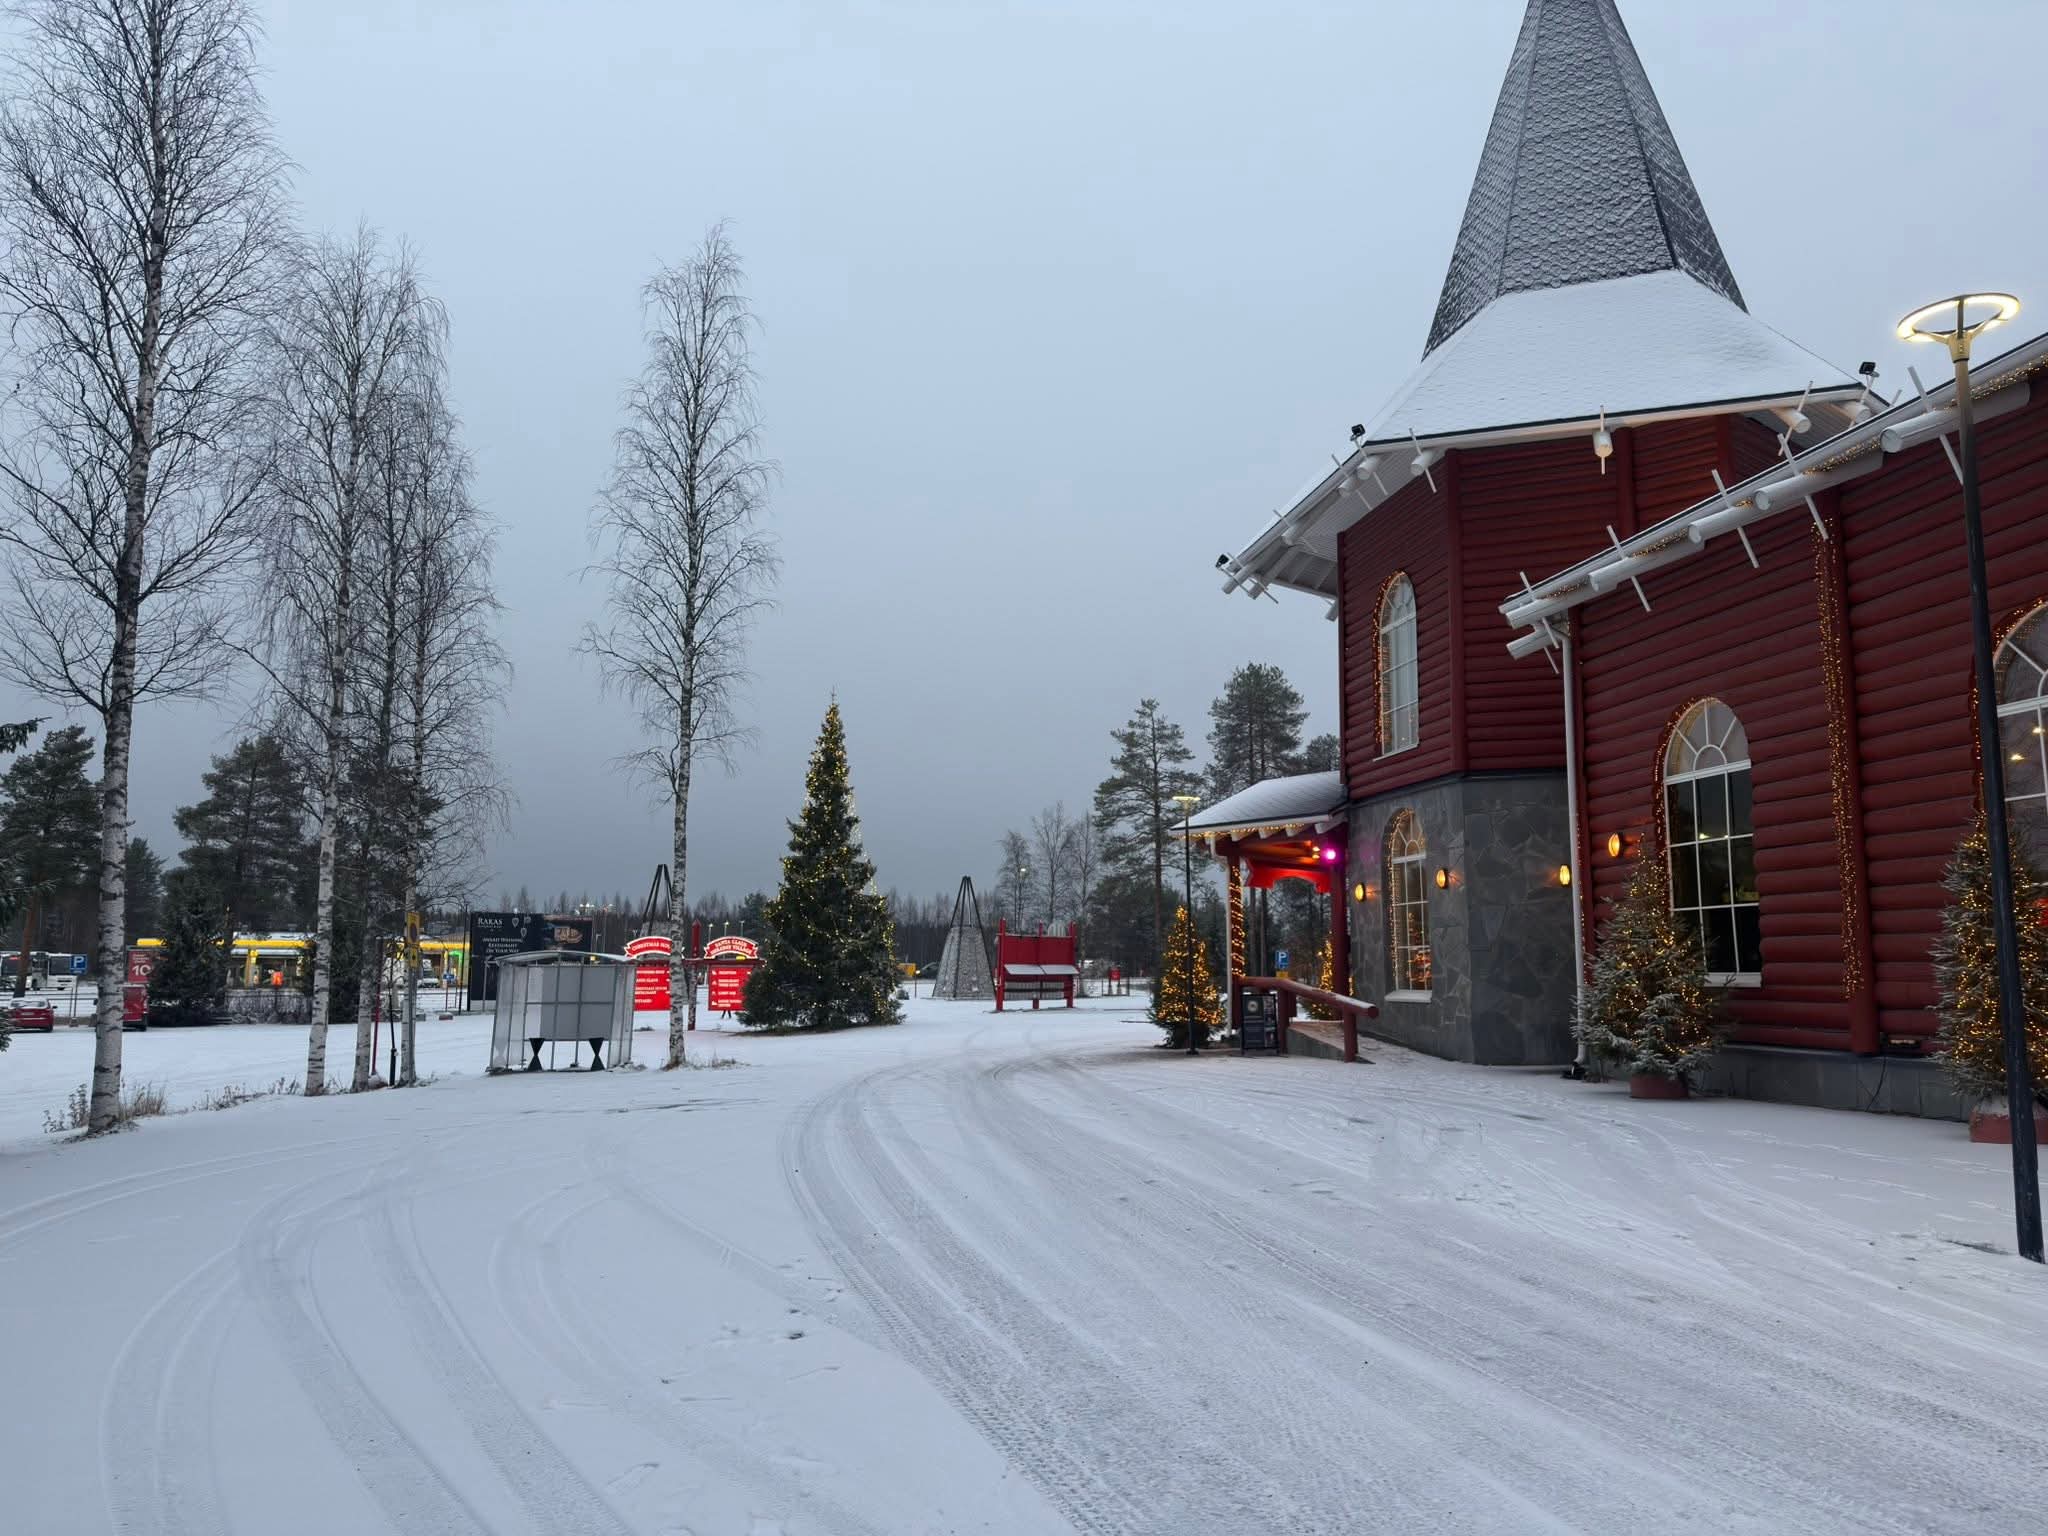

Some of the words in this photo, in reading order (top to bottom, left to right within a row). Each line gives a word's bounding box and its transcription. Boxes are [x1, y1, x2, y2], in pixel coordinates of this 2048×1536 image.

[478, 917, 503, 925] RAKAS
[73, 956, 84, 968] P
[1279, 951, 1287, 962] P
